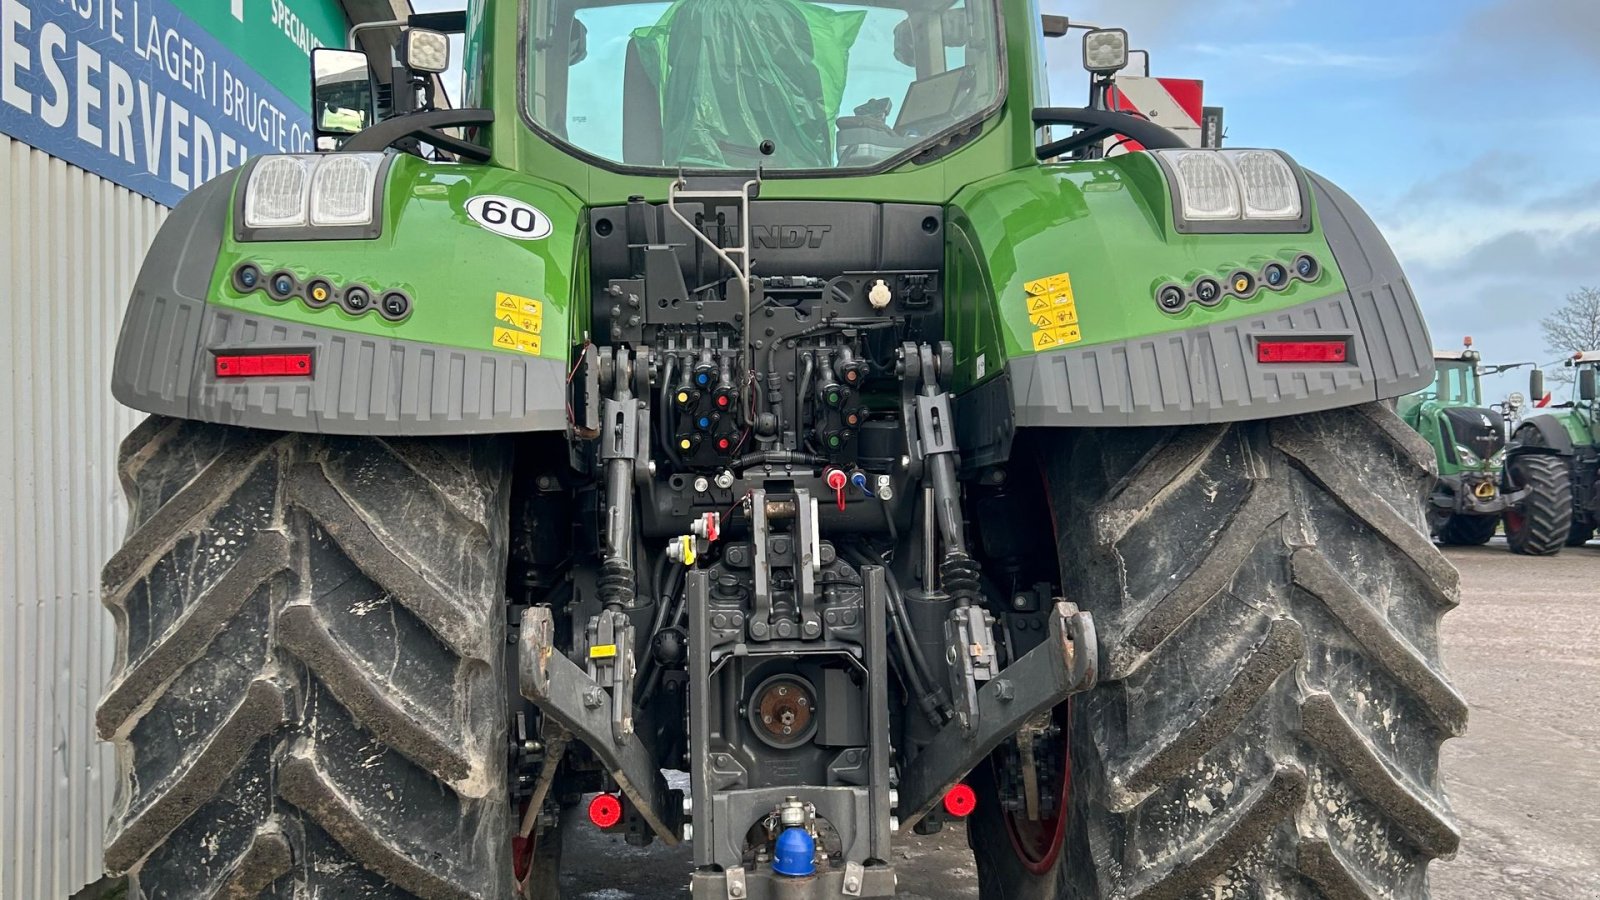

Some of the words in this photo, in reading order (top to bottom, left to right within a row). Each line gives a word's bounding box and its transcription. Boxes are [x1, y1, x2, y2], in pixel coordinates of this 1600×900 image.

[2, 0, 248, 191] ESERVEDE
[134, 1, 206, 99] LAGER
[212, 61, 217, 107] I
[223, 69, 287, 153] BRUGTE
[482, 200, 536, 232] 60
